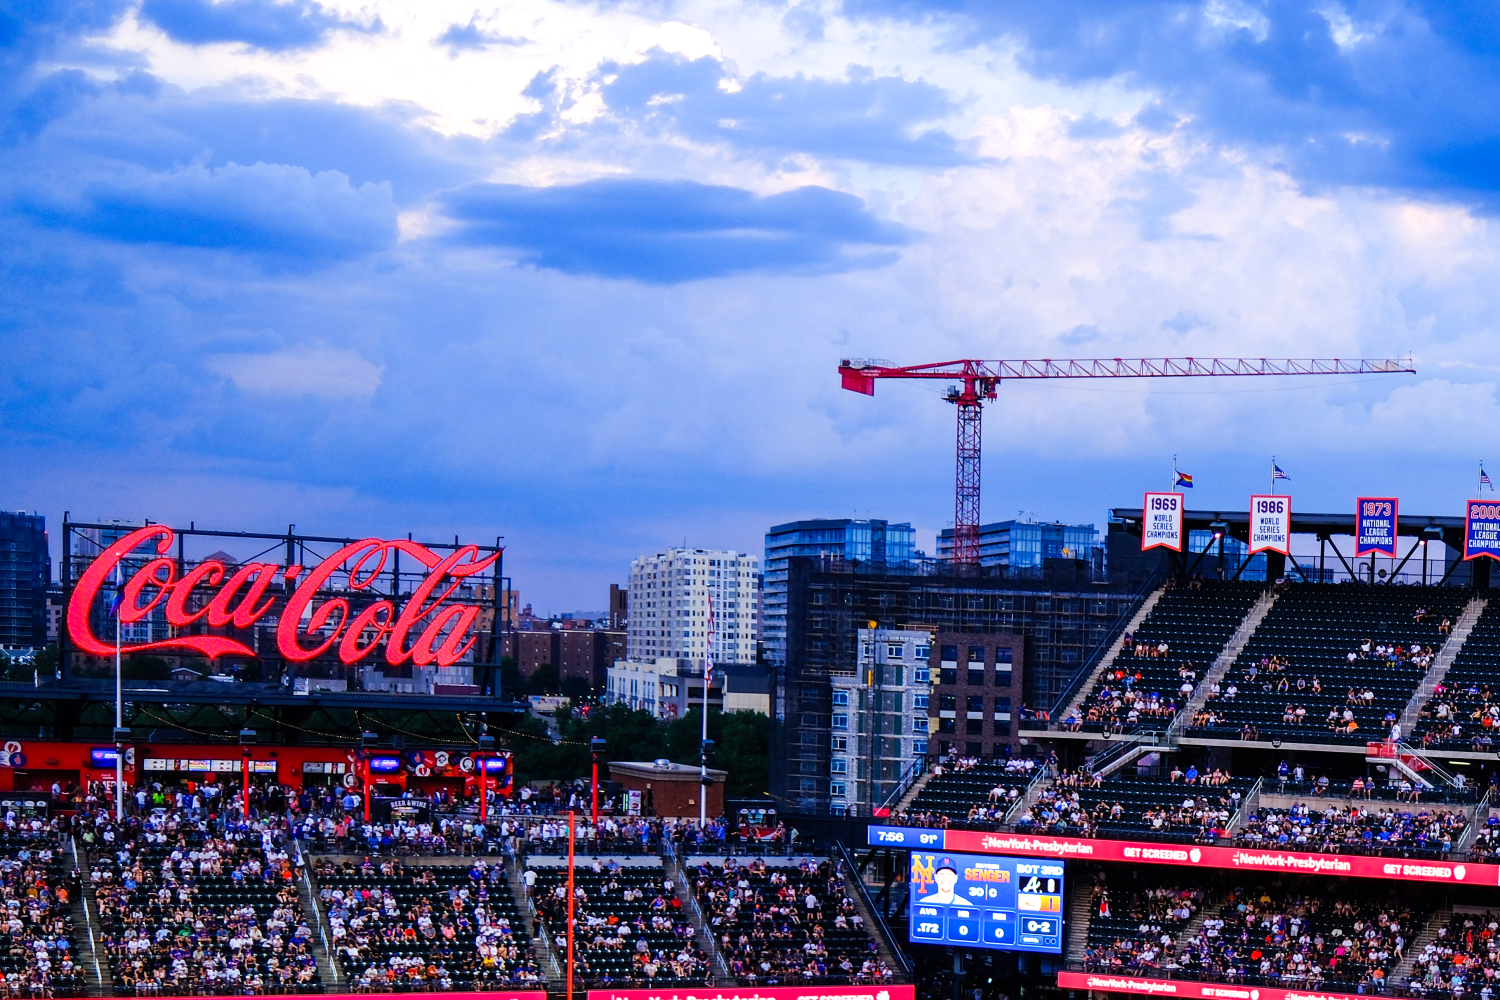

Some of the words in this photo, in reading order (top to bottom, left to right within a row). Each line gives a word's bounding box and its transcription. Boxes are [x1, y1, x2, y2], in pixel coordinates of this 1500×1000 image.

[1152, 498, 1176, 510] 1969
[1257, 501, 1283, 513] 1986
[1363, 502, 1392, 516] 1973
[1154, 514, 1173, 522] WORLD
[1260, 518, 1280, 526] WORLD
[1362, 519, 1391, 528] NATIONAL
[1153, 522, 1173, 530] SERIES
[1259, 526, 1280, 534] SERIES
[1146, 530, 1178, 539] CHAMPIONS
[1365, 528, 1388, 536] LEAGUE
[1474, 531, 1498, 540] LEAGUE
[1253, 534, 1285, 542] CHAMPIONS
[1359, 536, 1393, 545] CHAMPIONS
[67, 525, 505, 667] Coca-Cola
[411, 800, 427, 808] WINE
[878, 831, 904, 842] 7:56
[988, 835, 1093, 855] NewYork-Presbyterian
[1124, 847, 1141, 857] GET
[1142, 849, 1188, 860] SCREENED
[1240, 853, 1350, 871] NewYork-Presbyterian
[1017, 864, 1039, 874] BOT
[1041, 866, 1063, 875] 3RD
[1384, 864, 1402, 874] GET
[1403, 865, 1451, 877] SCREENED
[964, 868, 1010, 883] SENGER
[969, 887, 984, 896] 30
[1048, 898, 1054, 909] 1
[917, 923, 939, 933] .172
[959, 926, 968, 935] 0
[995, 928, 1004, 938] 0
[1028, 921, 1050, 932] 0-2
[1091, 976, 1176, 993] NewYork-Presbyterian
[1202, 988, 1216, 996] GET
[1215, 989, 1249, 998] SCREENED
